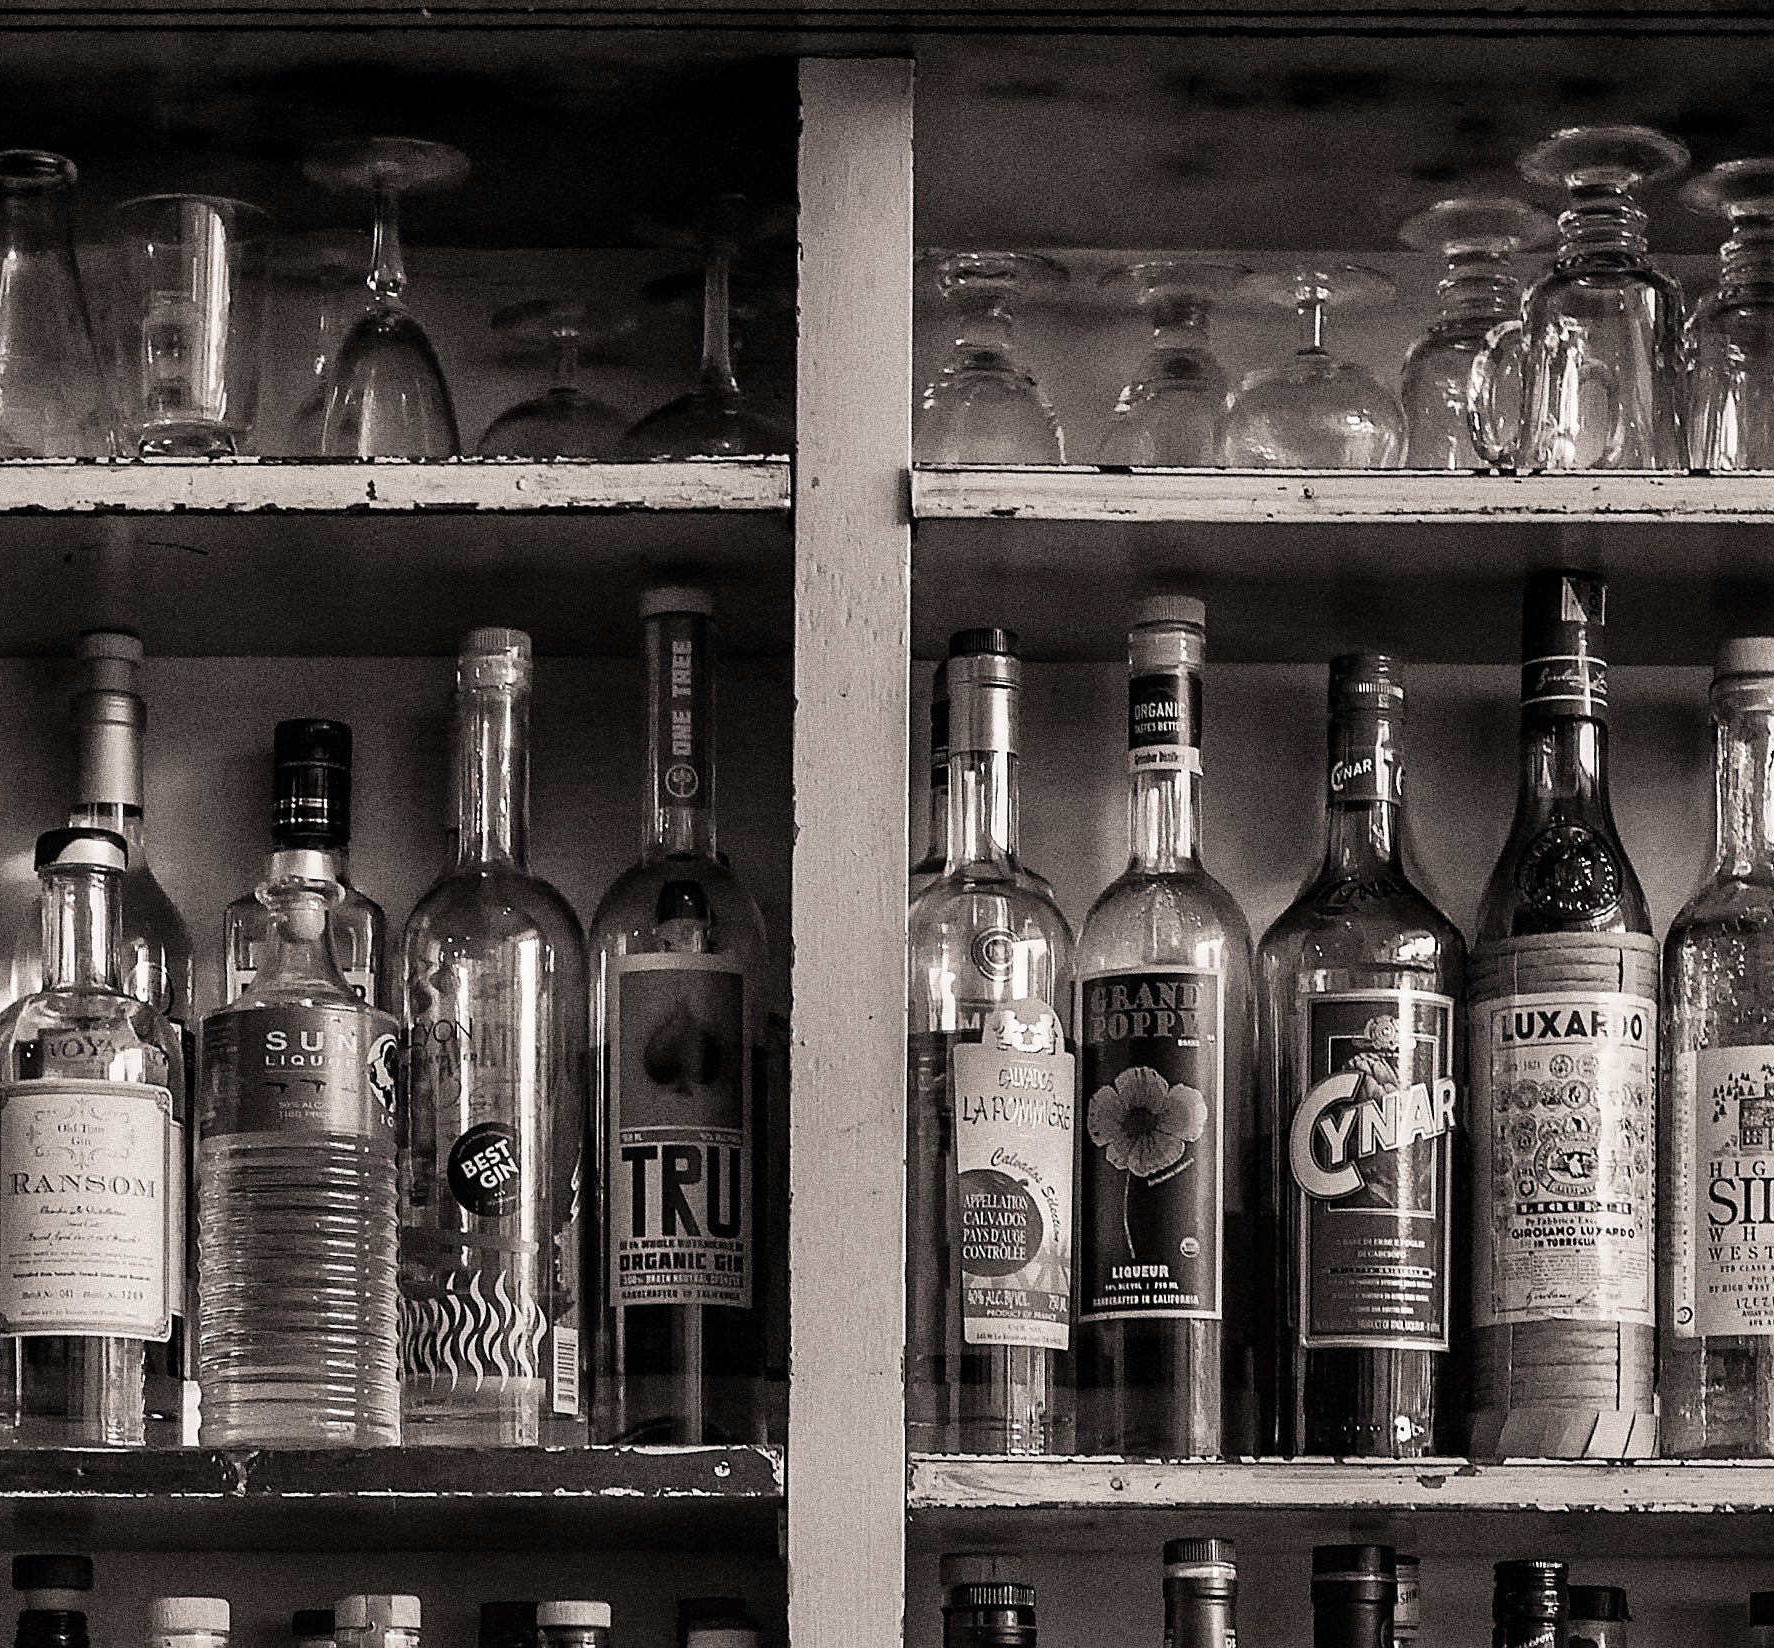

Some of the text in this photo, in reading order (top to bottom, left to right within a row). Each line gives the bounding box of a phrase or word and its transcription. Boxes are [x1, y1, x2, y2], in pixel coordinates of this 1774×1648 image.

[672, 641, 691, 755] ONE TREE
[1135, 701, 1188, 720] ORGANIC
[1331, 759, 1372, 791] CYNAR
[1090, 982, 1198, 1012] GRAND
[1088, 1011, 1198, 1042] POPPY
[265, 1030, 357, 1050] SUN
[963, 1097, 988, 1122] LA
[1289, 1069, 1457, 1199] CYNAR
[460, 1138, 509, 1178] BEST
[991, 1147, 1043, 1184] Calvados
[10, 1173, 155, 1198] RANSOM
[480, 1160, 519, 1188] GIN
[621, 1145, 741, 1238] TRU
[964, 1194, 1027, 1209] APPELLATION
[963, 1212, 1026, 1226] CALVADOS
[963, 1228, 989, 1243] PAYS
[1512, 1226, 1576, 1240] GIROLAMO
[620, 1253, 744, 1271] ORGANIC GIN
[1112, 1265, 1169, 1279] LIQUEUR
